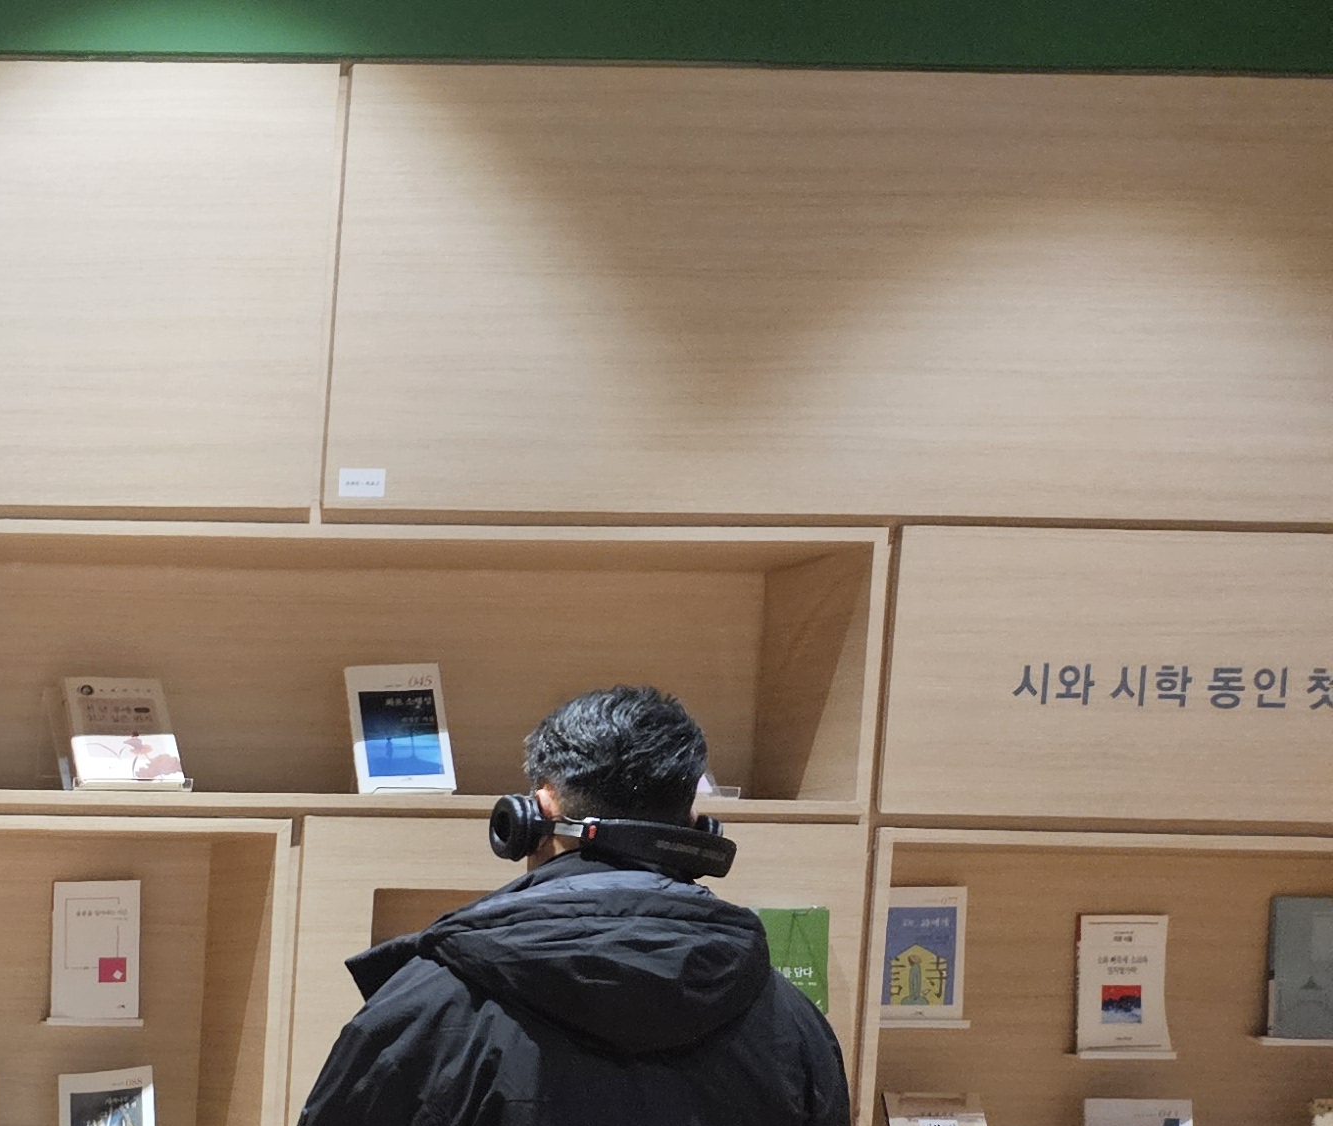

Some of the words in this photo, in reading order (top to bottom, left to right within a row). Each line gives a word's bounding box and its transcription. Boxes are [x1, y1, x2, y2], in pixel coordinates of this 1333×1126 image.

[1012, 662, 1095, 706] 시와
[1109, 664, 1193, 708] 시학
[1207, 666, 1289, 710] 동인
[794, 966, 814, 978] 담다
